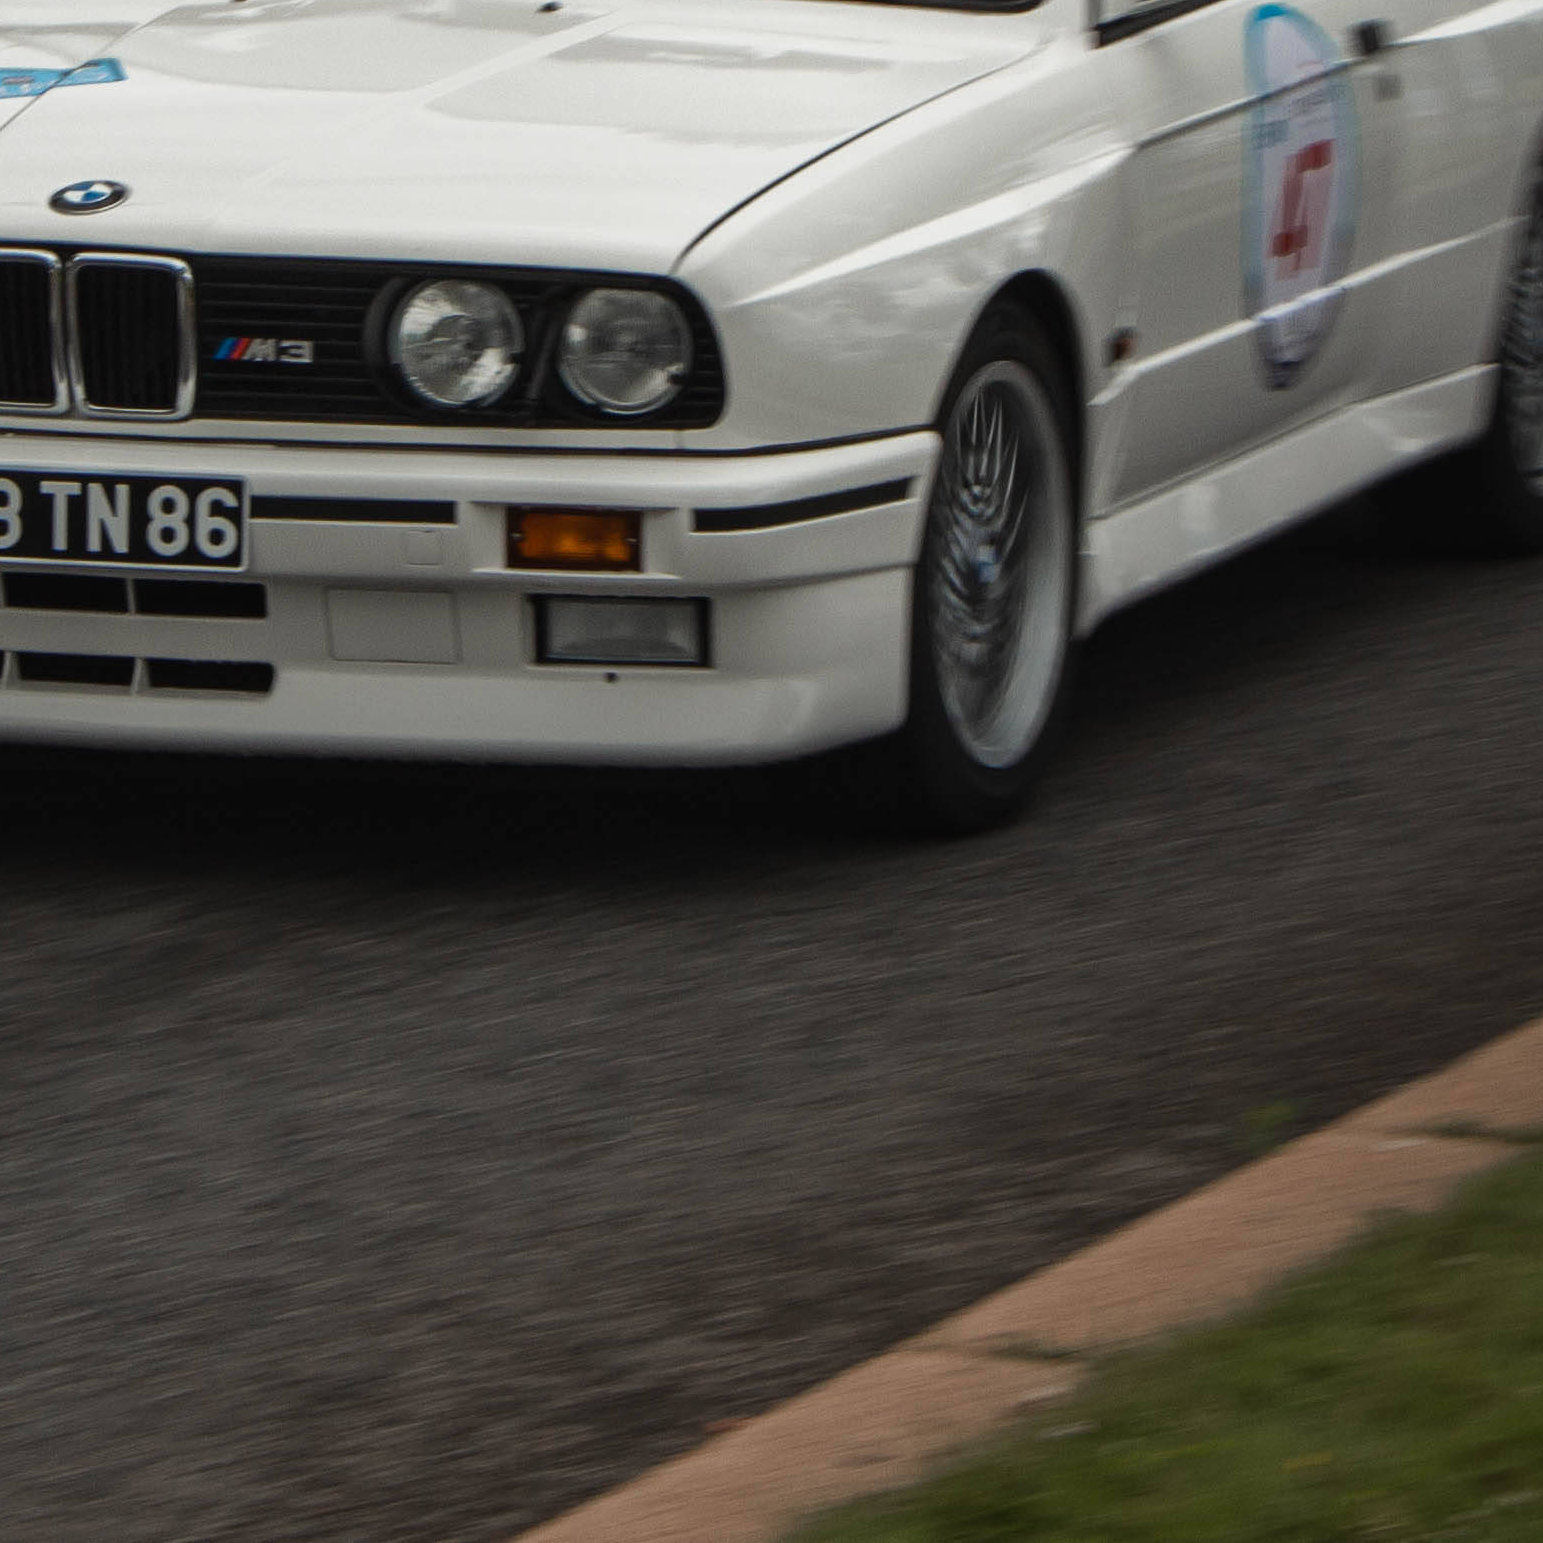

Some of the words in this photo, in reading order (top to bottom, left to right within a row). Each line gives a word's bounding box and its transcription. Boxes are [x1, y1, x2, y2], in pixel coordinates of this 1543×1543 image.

[239, 337, 315, 364] M3
[38, 479, 131, 554] TN
[145, 484, 239, 559] 86
